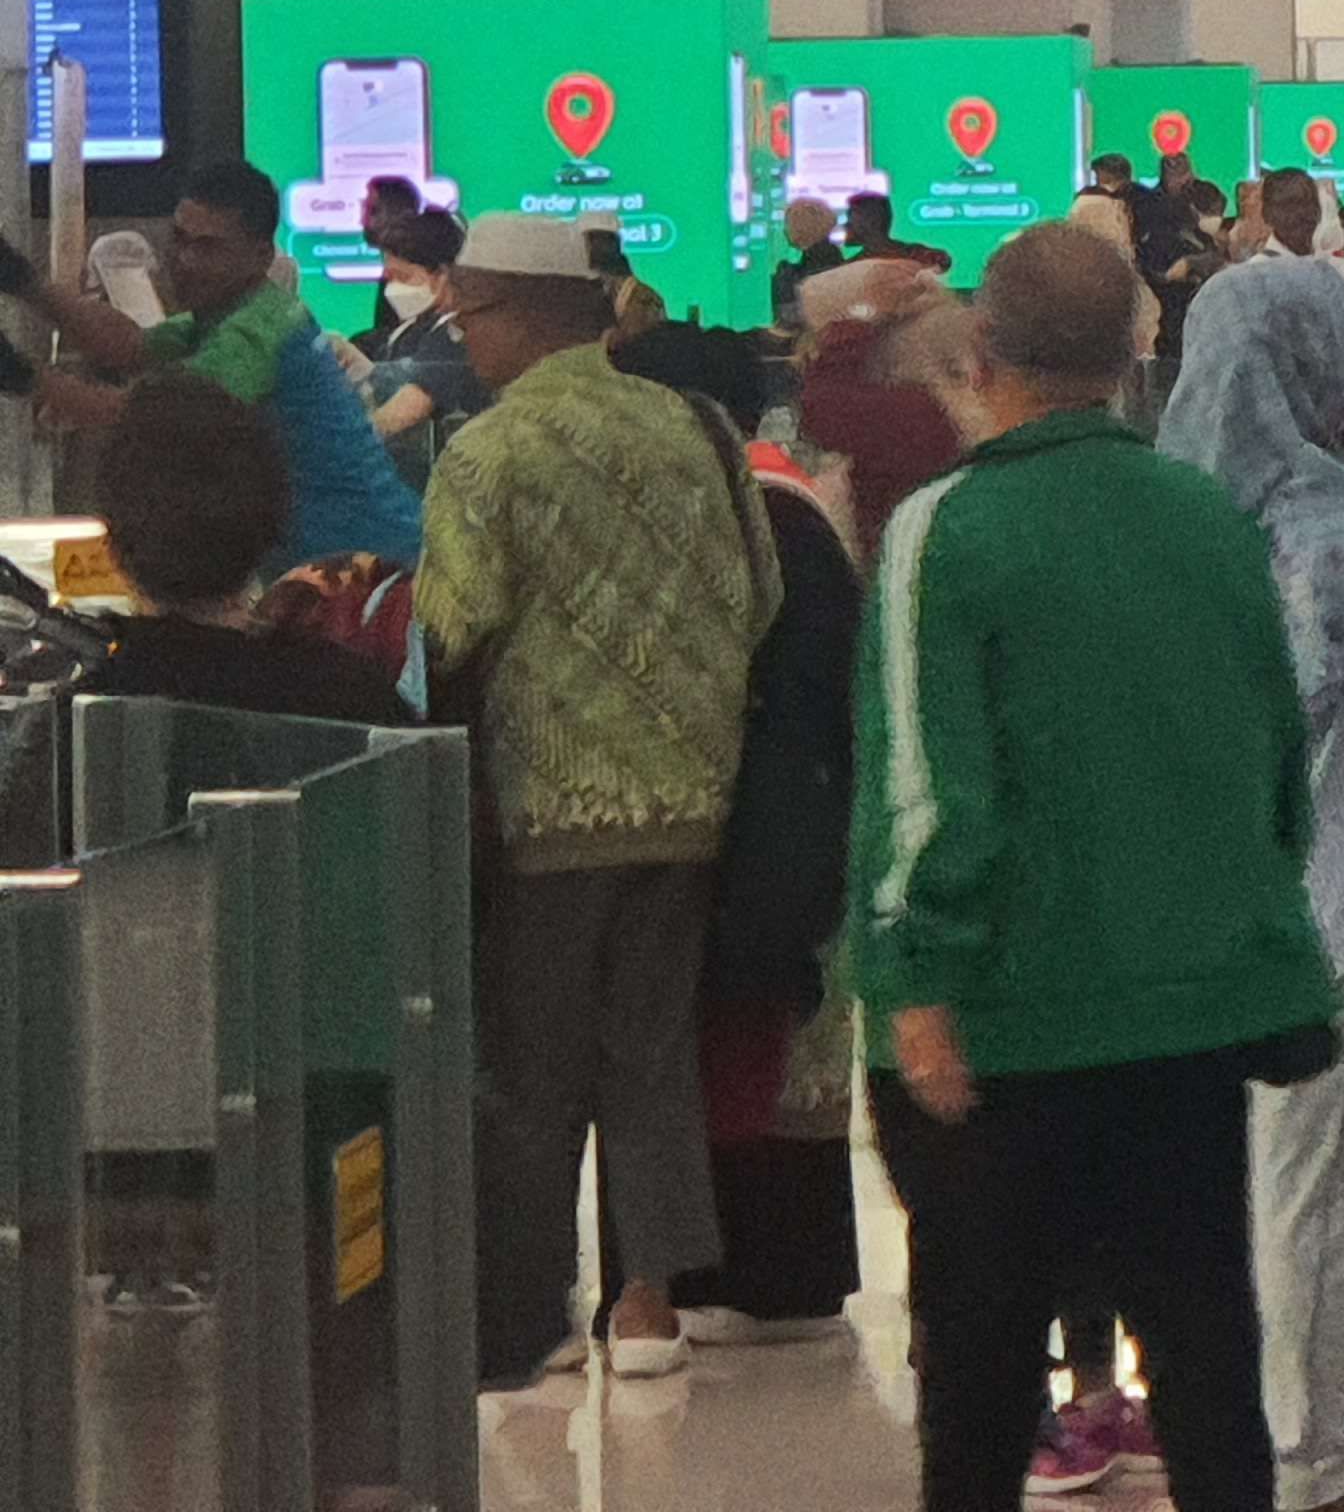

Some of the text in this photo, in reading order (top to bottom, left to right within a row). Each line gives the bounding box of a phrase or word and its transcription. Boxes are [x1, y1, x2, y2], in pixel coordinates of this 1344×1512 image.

[310, 199, 345, 212] Grab
[520, 194, 643, 212] Order now at
